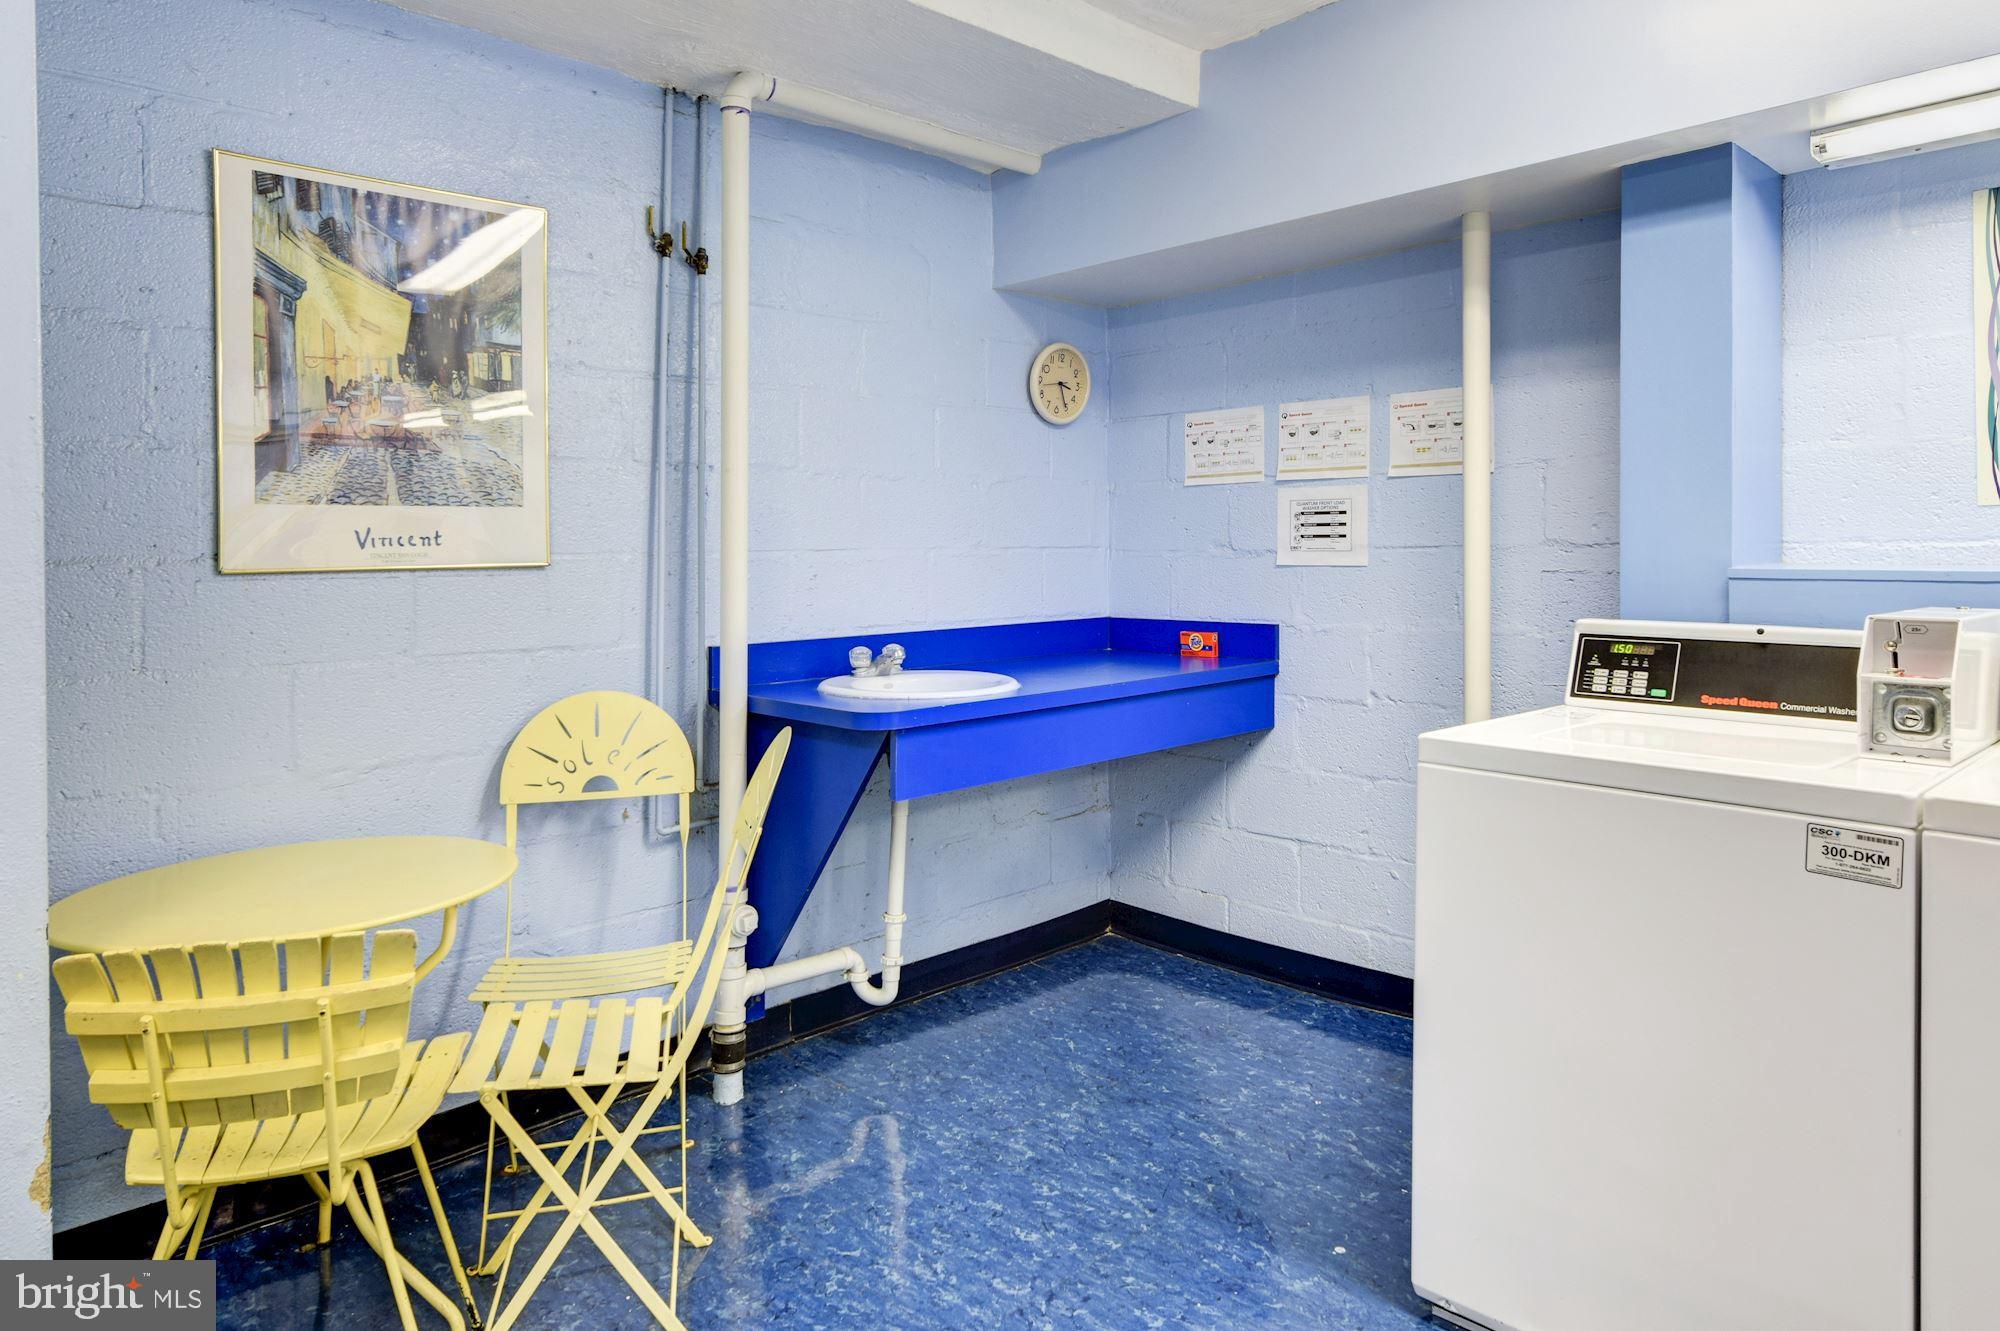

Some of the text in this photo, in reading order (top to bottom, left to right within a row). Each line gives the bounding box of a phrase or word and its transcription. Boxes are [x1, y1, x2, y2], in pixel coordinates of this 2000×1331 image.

[1073, 369, 1079, 378] 2
[1070, 395, 1076, 403] 4
[1053, 406, 1059, 414] 6
[354, 526, 442, 550] Vincent
[1700, 694, 1739, 706] Speed
[1739, 697, 1779, 709] Queen
[1780, 702, 1827, 714] Commercial
[1810, 827, 1834, 836] CSC
[1821, 844, 1890, 867] 300-DKM
